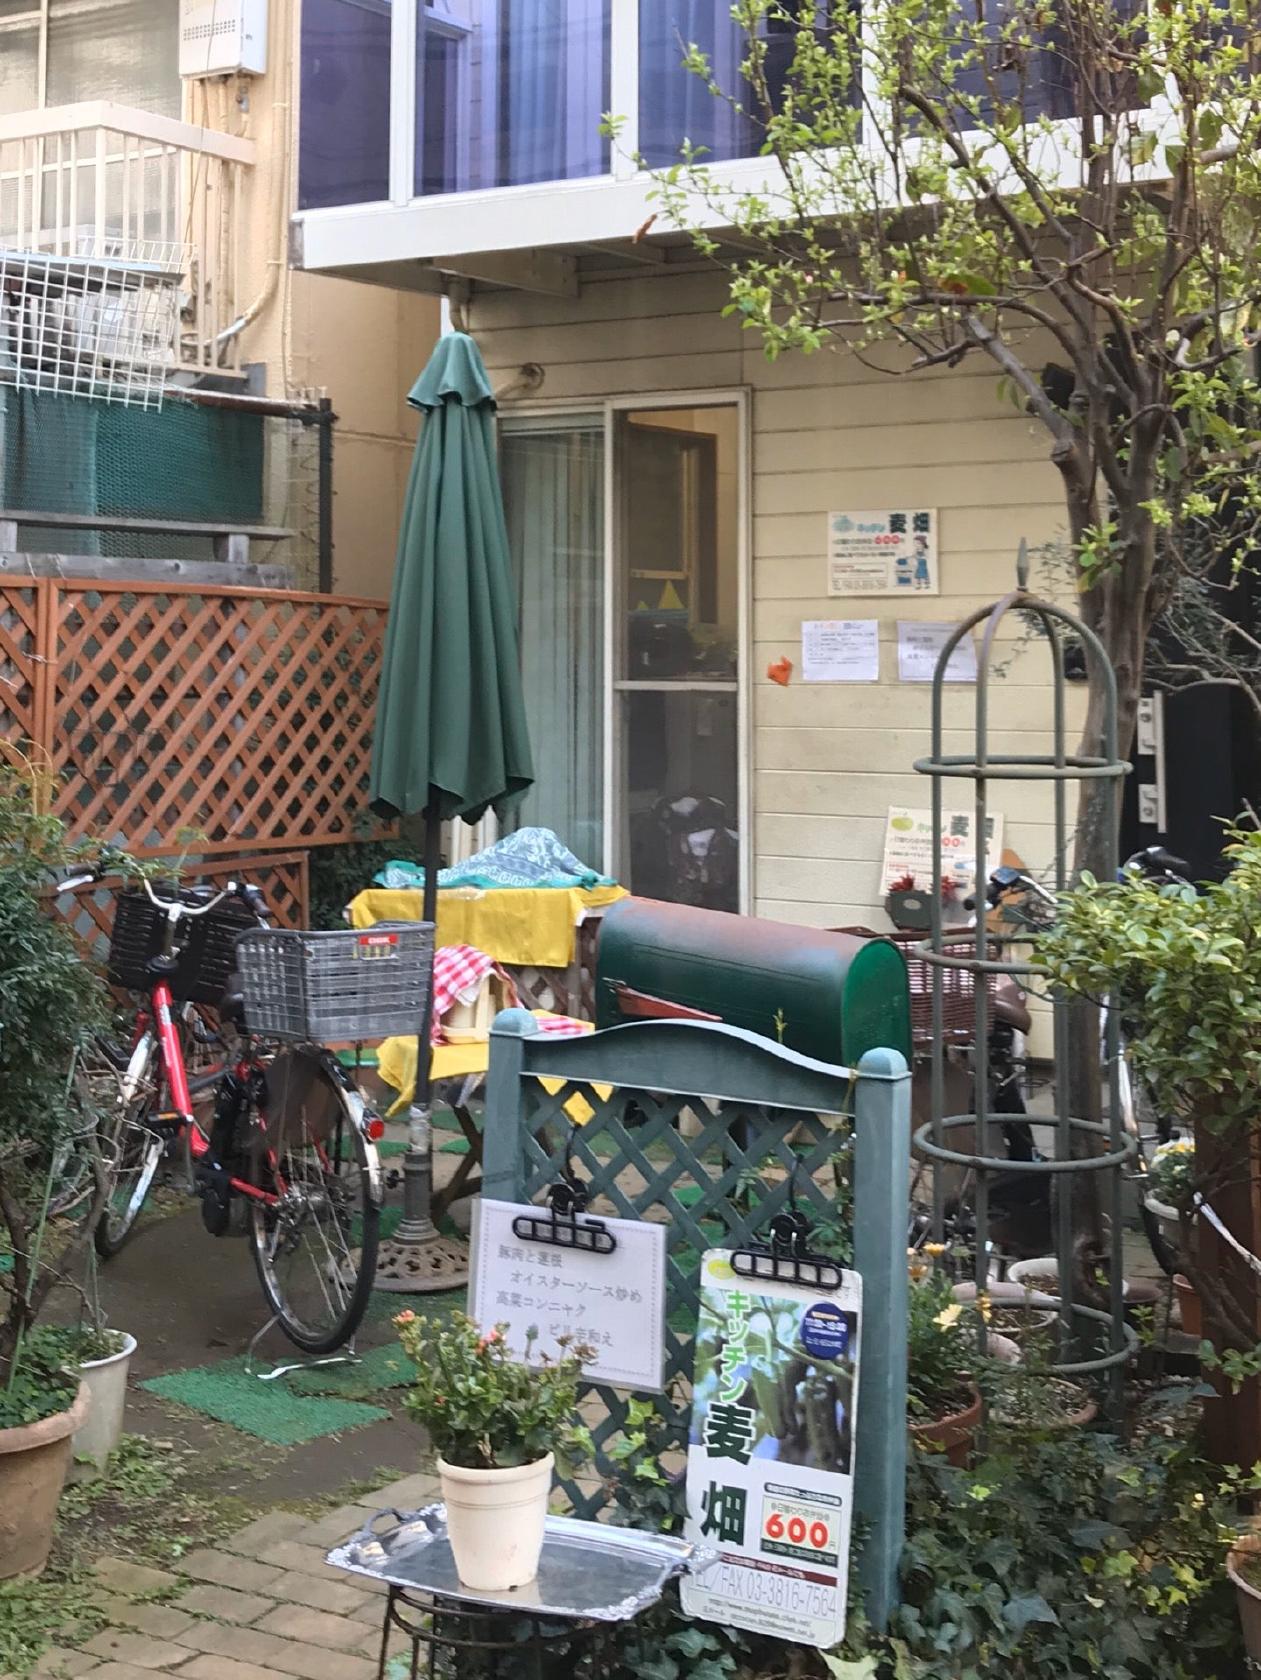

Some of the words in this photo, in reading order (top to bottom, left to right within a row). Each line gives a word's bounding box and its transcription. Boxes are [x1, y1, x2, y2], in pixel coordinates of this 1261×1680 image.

[719, 1289, 750, 1402] キッチン
[701, 1402, 755, 1546] 麦畑
